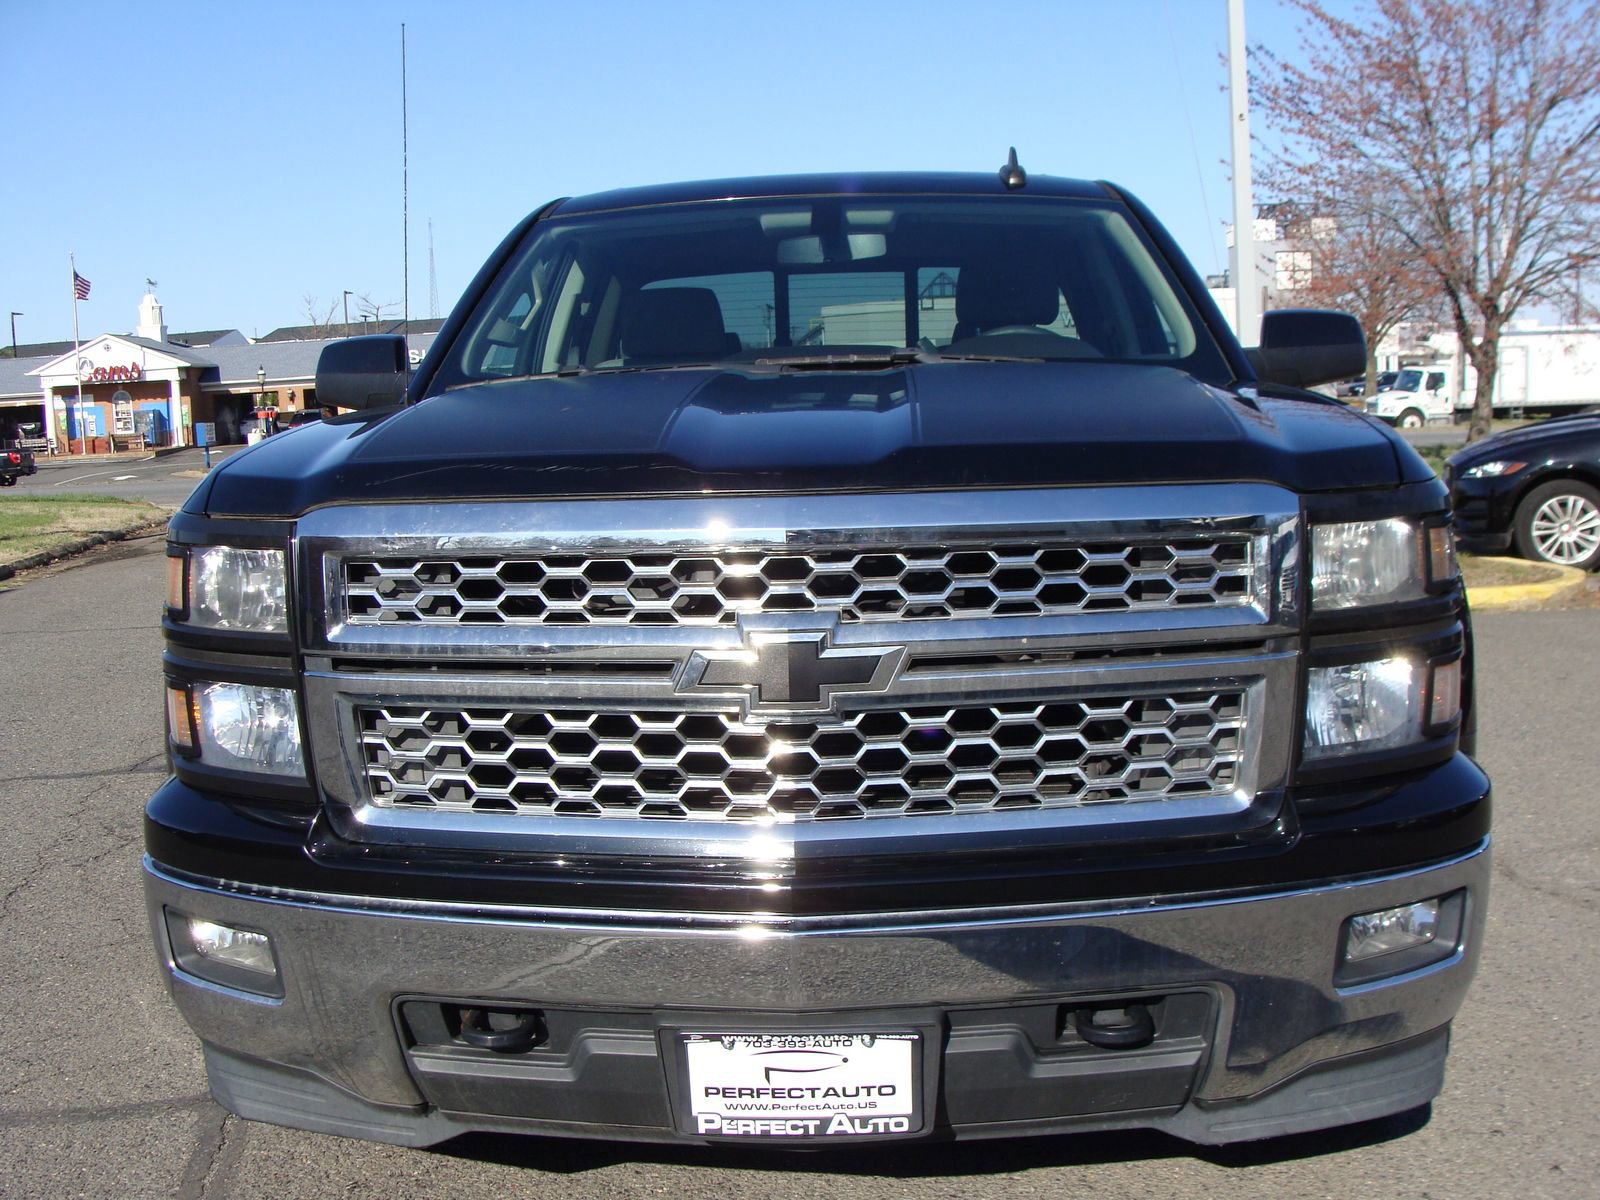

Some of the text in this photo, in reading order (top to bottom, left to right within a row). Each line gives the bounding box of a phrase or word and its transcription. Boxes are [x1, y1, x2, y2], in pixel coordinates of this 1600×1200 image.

[745, 1040, 853, 1048] 703-393-AUTO
[704, 1085, 896, 1099] PERFECTAUTO
[724, 1101, 878, 1110] WWW.PerfectAuto.US
[697, 1112, 910, 1136] PERFECT AUTO
